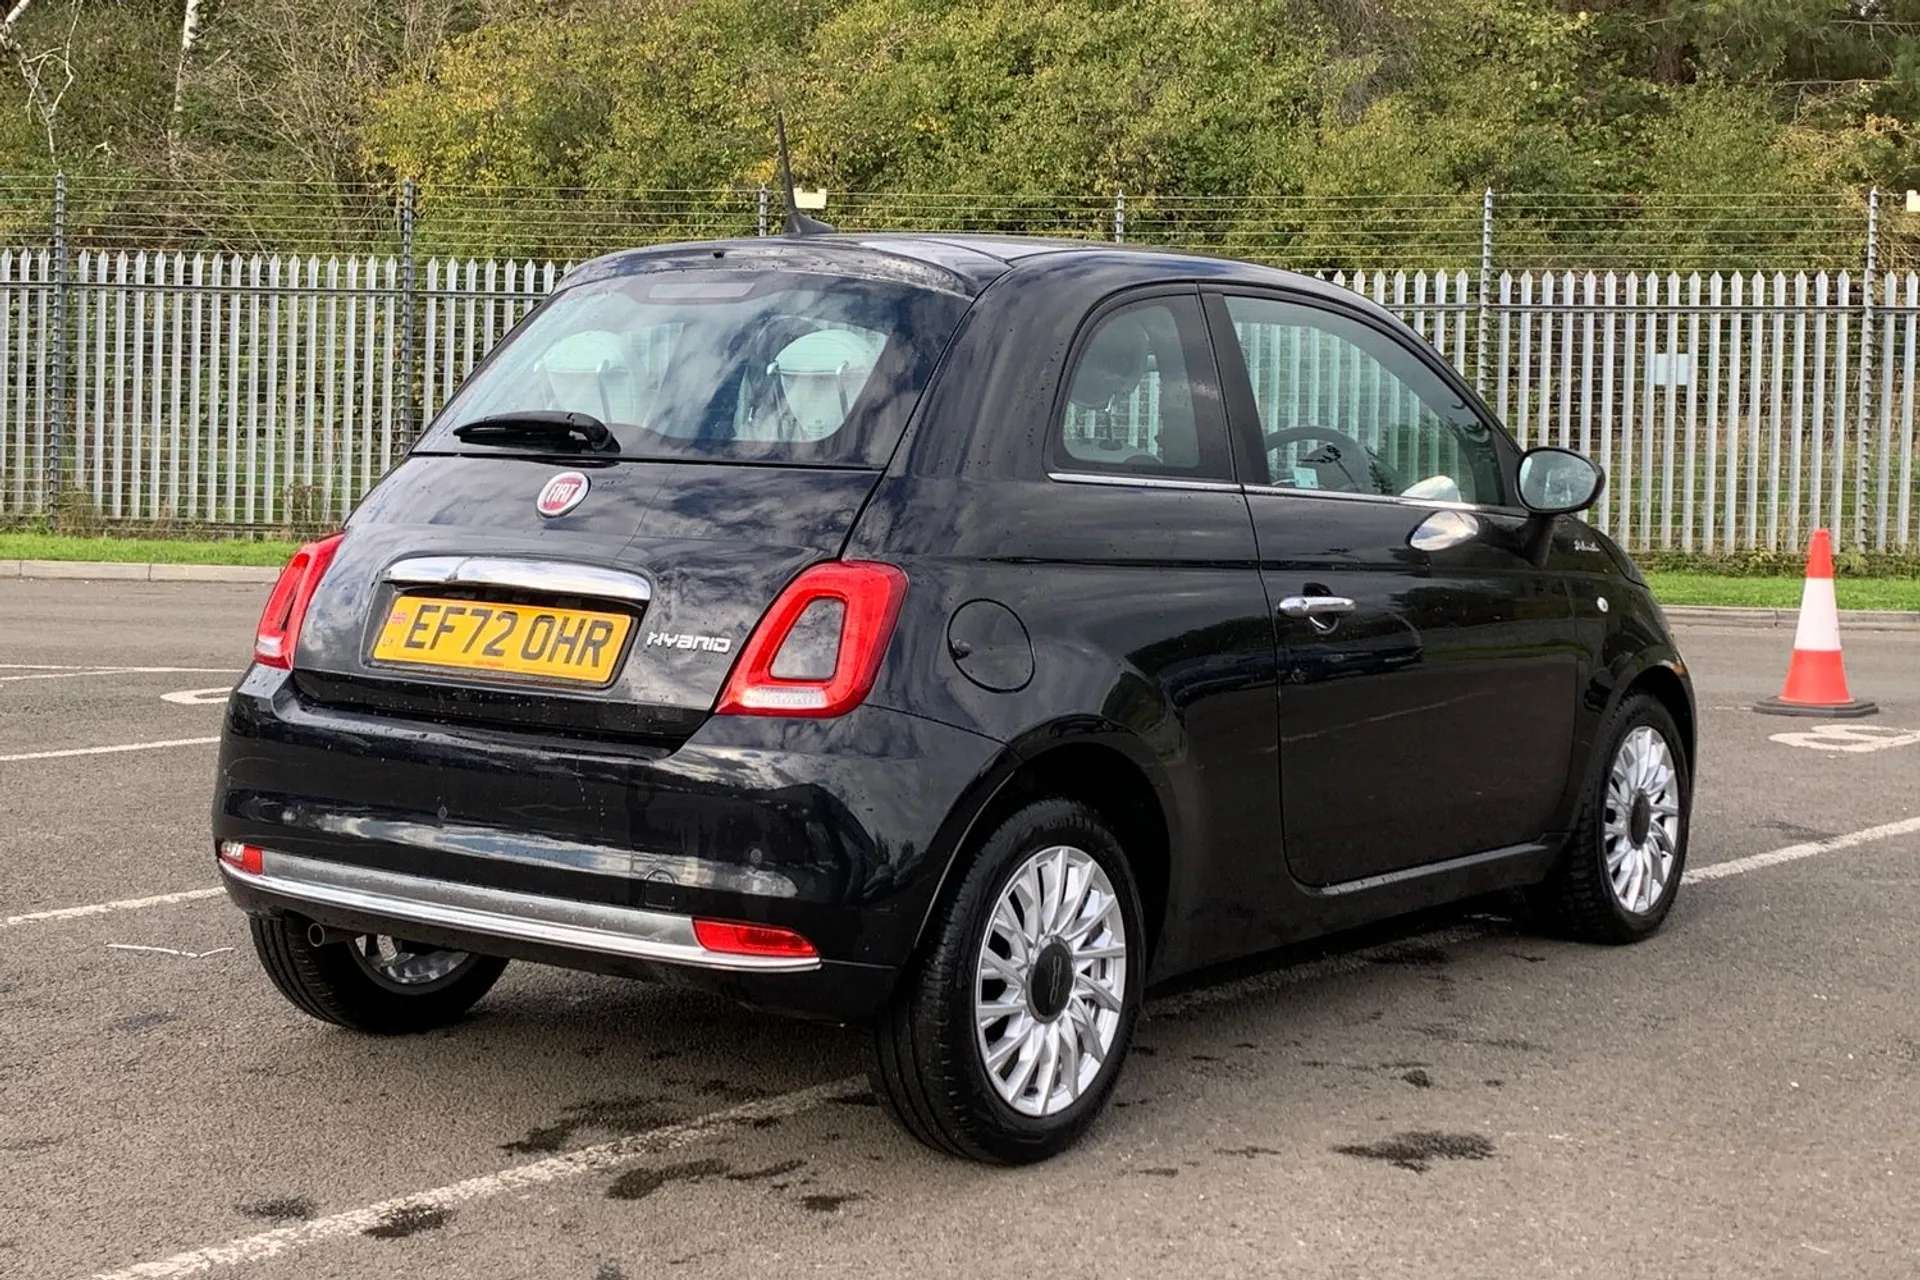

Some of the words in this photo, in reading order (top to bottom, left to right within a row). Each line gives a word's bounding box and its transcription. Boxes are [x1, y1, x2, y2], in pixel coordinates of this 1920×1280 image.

[404, 605, 518, 657] EF72
[520, 614, 614, 667] OHR
[646, 631, 731, 653] HYBRID
